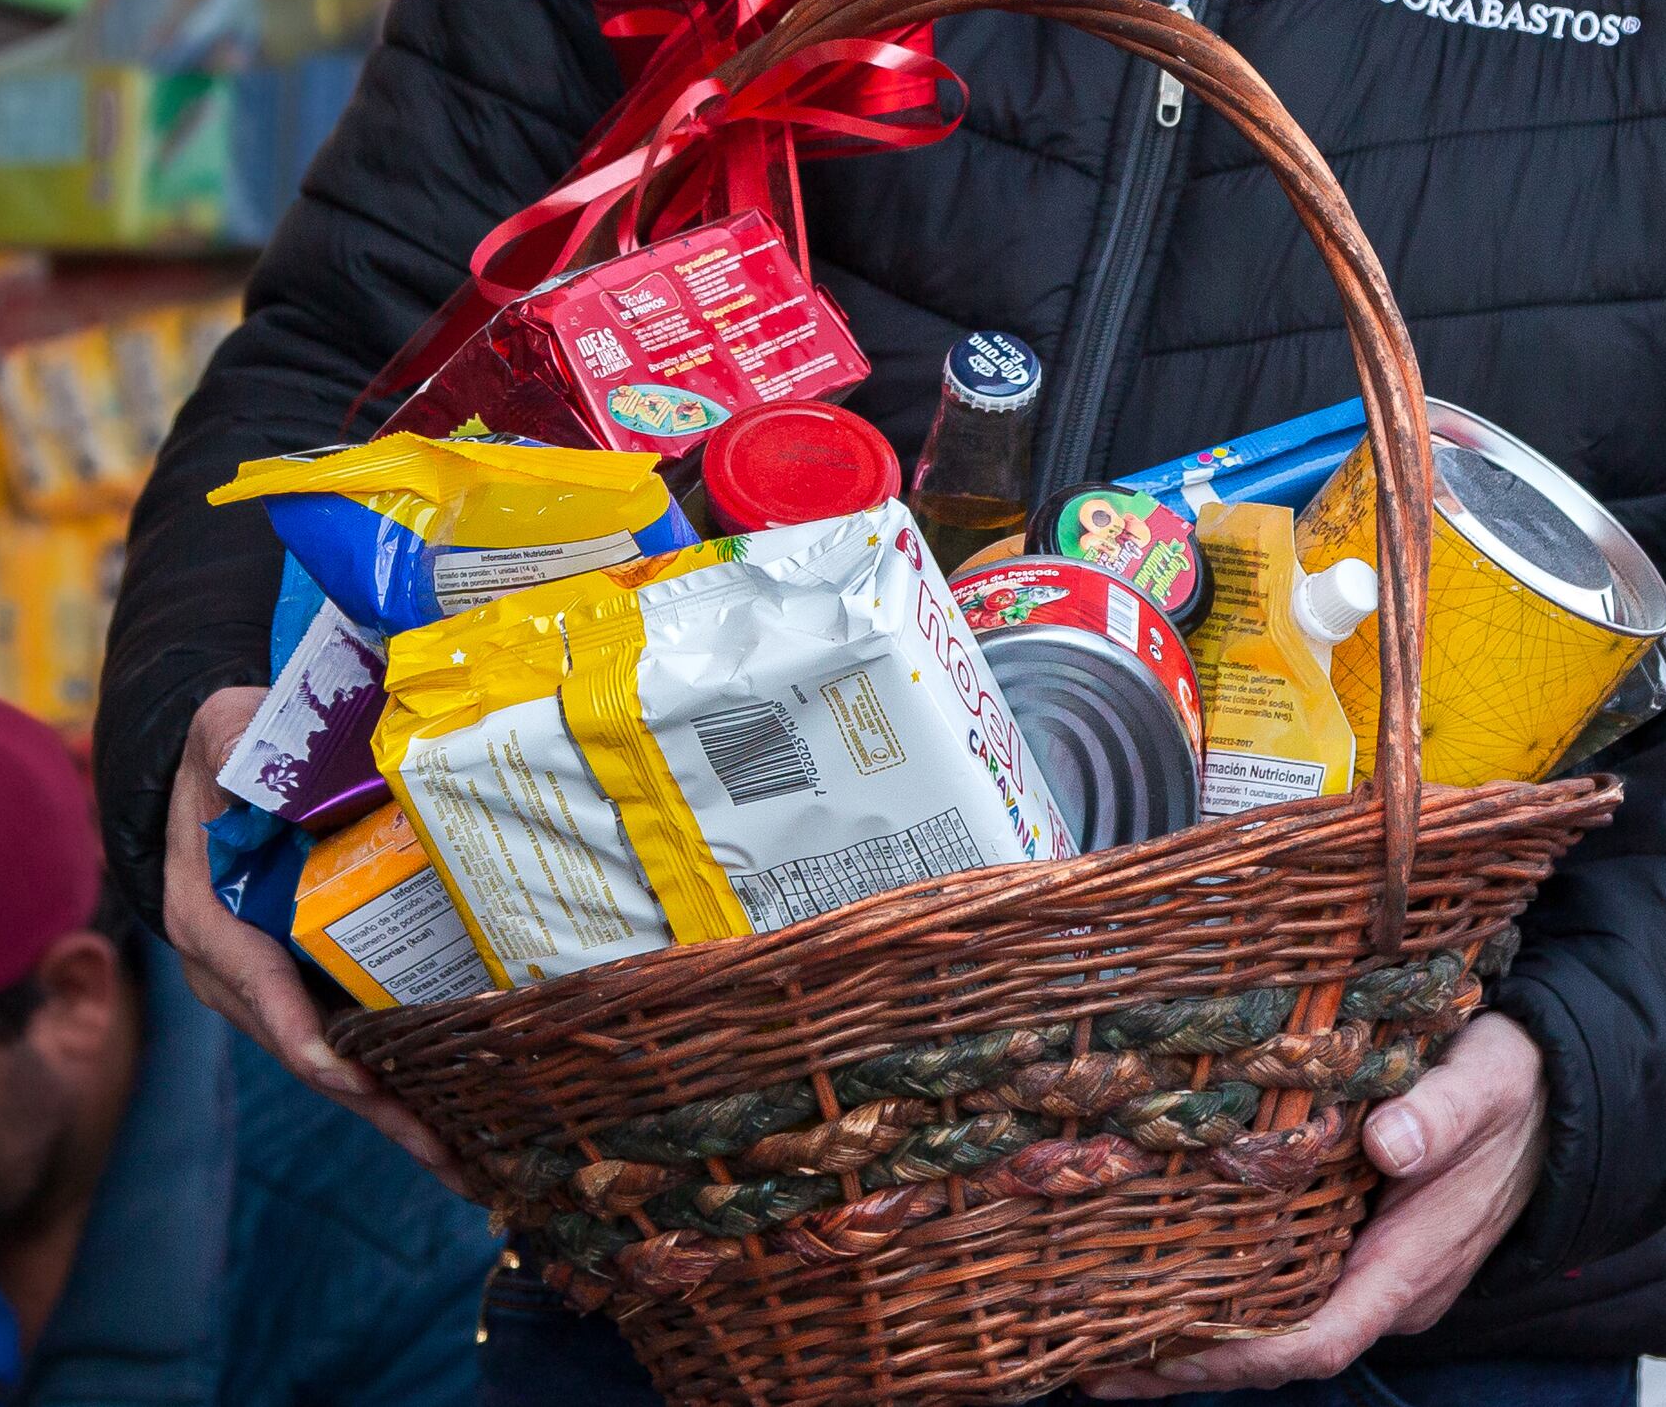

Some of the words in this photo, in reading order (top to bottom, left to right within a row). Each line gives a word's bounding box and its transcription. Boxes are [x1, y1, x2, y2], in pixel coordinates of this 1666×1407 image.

[619, 289, 654, 307] Tarde
[619, 310, 634, 321] DE
[634, 297, 667, 318] PRIMOS
[575, 327, 618, 358] IDEAS
[993, 335, 1027, 365] Extra
[585, 357, 599, 370] QUE
[597, 344, 627, 367] UNEN
[593, 369, 599, 379] A
[600, 366, 609, 379] LA
[608, 357, 633, 375] FAMILIA
[968, 333, 1029, 385] Corona
[664, 367, 676, 378] con
[480, 552, 522, 563] Información
[523, 547, 564, 559] Nutricional
[1134, 540, 1173, 589] Maldona
[470, 577, 499, 587] porciones
[500, 576, 511, 585] por
[498, 566, 519, 575] unidad
[989, 574, 1005, 583] de
[1008, 569, 1060, 579] Pescado
[774, 701, 799, 736] 141166
[793, 737, 821, 784] 702025
[1204, 762, 1247, 778] rmación
[1249, 765, 1316, 786] Nutricional
[814, 789, 827, 797] 7
[968, 728, 1037, 861] CARAVANA
[1211, 797, 1240, 807] porciones
[1241, 801, 1253, 809] por
[1249, 789, 1288, 801] cucharada
[390, 871, 439, 900] Informaci
[387, 925, 400, 936] de
[400, 899, 443, 929] porciones
[342, 923, 378, 947] Tamaño
[378, 917, 391, 928] de
[406, 927, 435, 949] (kcal)
[389, 973, 417, 990] Grasa
[417, 960, 439, 976] total
[409, 977, 438, 995] Grasa
[450, 973, 477, 992] trans
